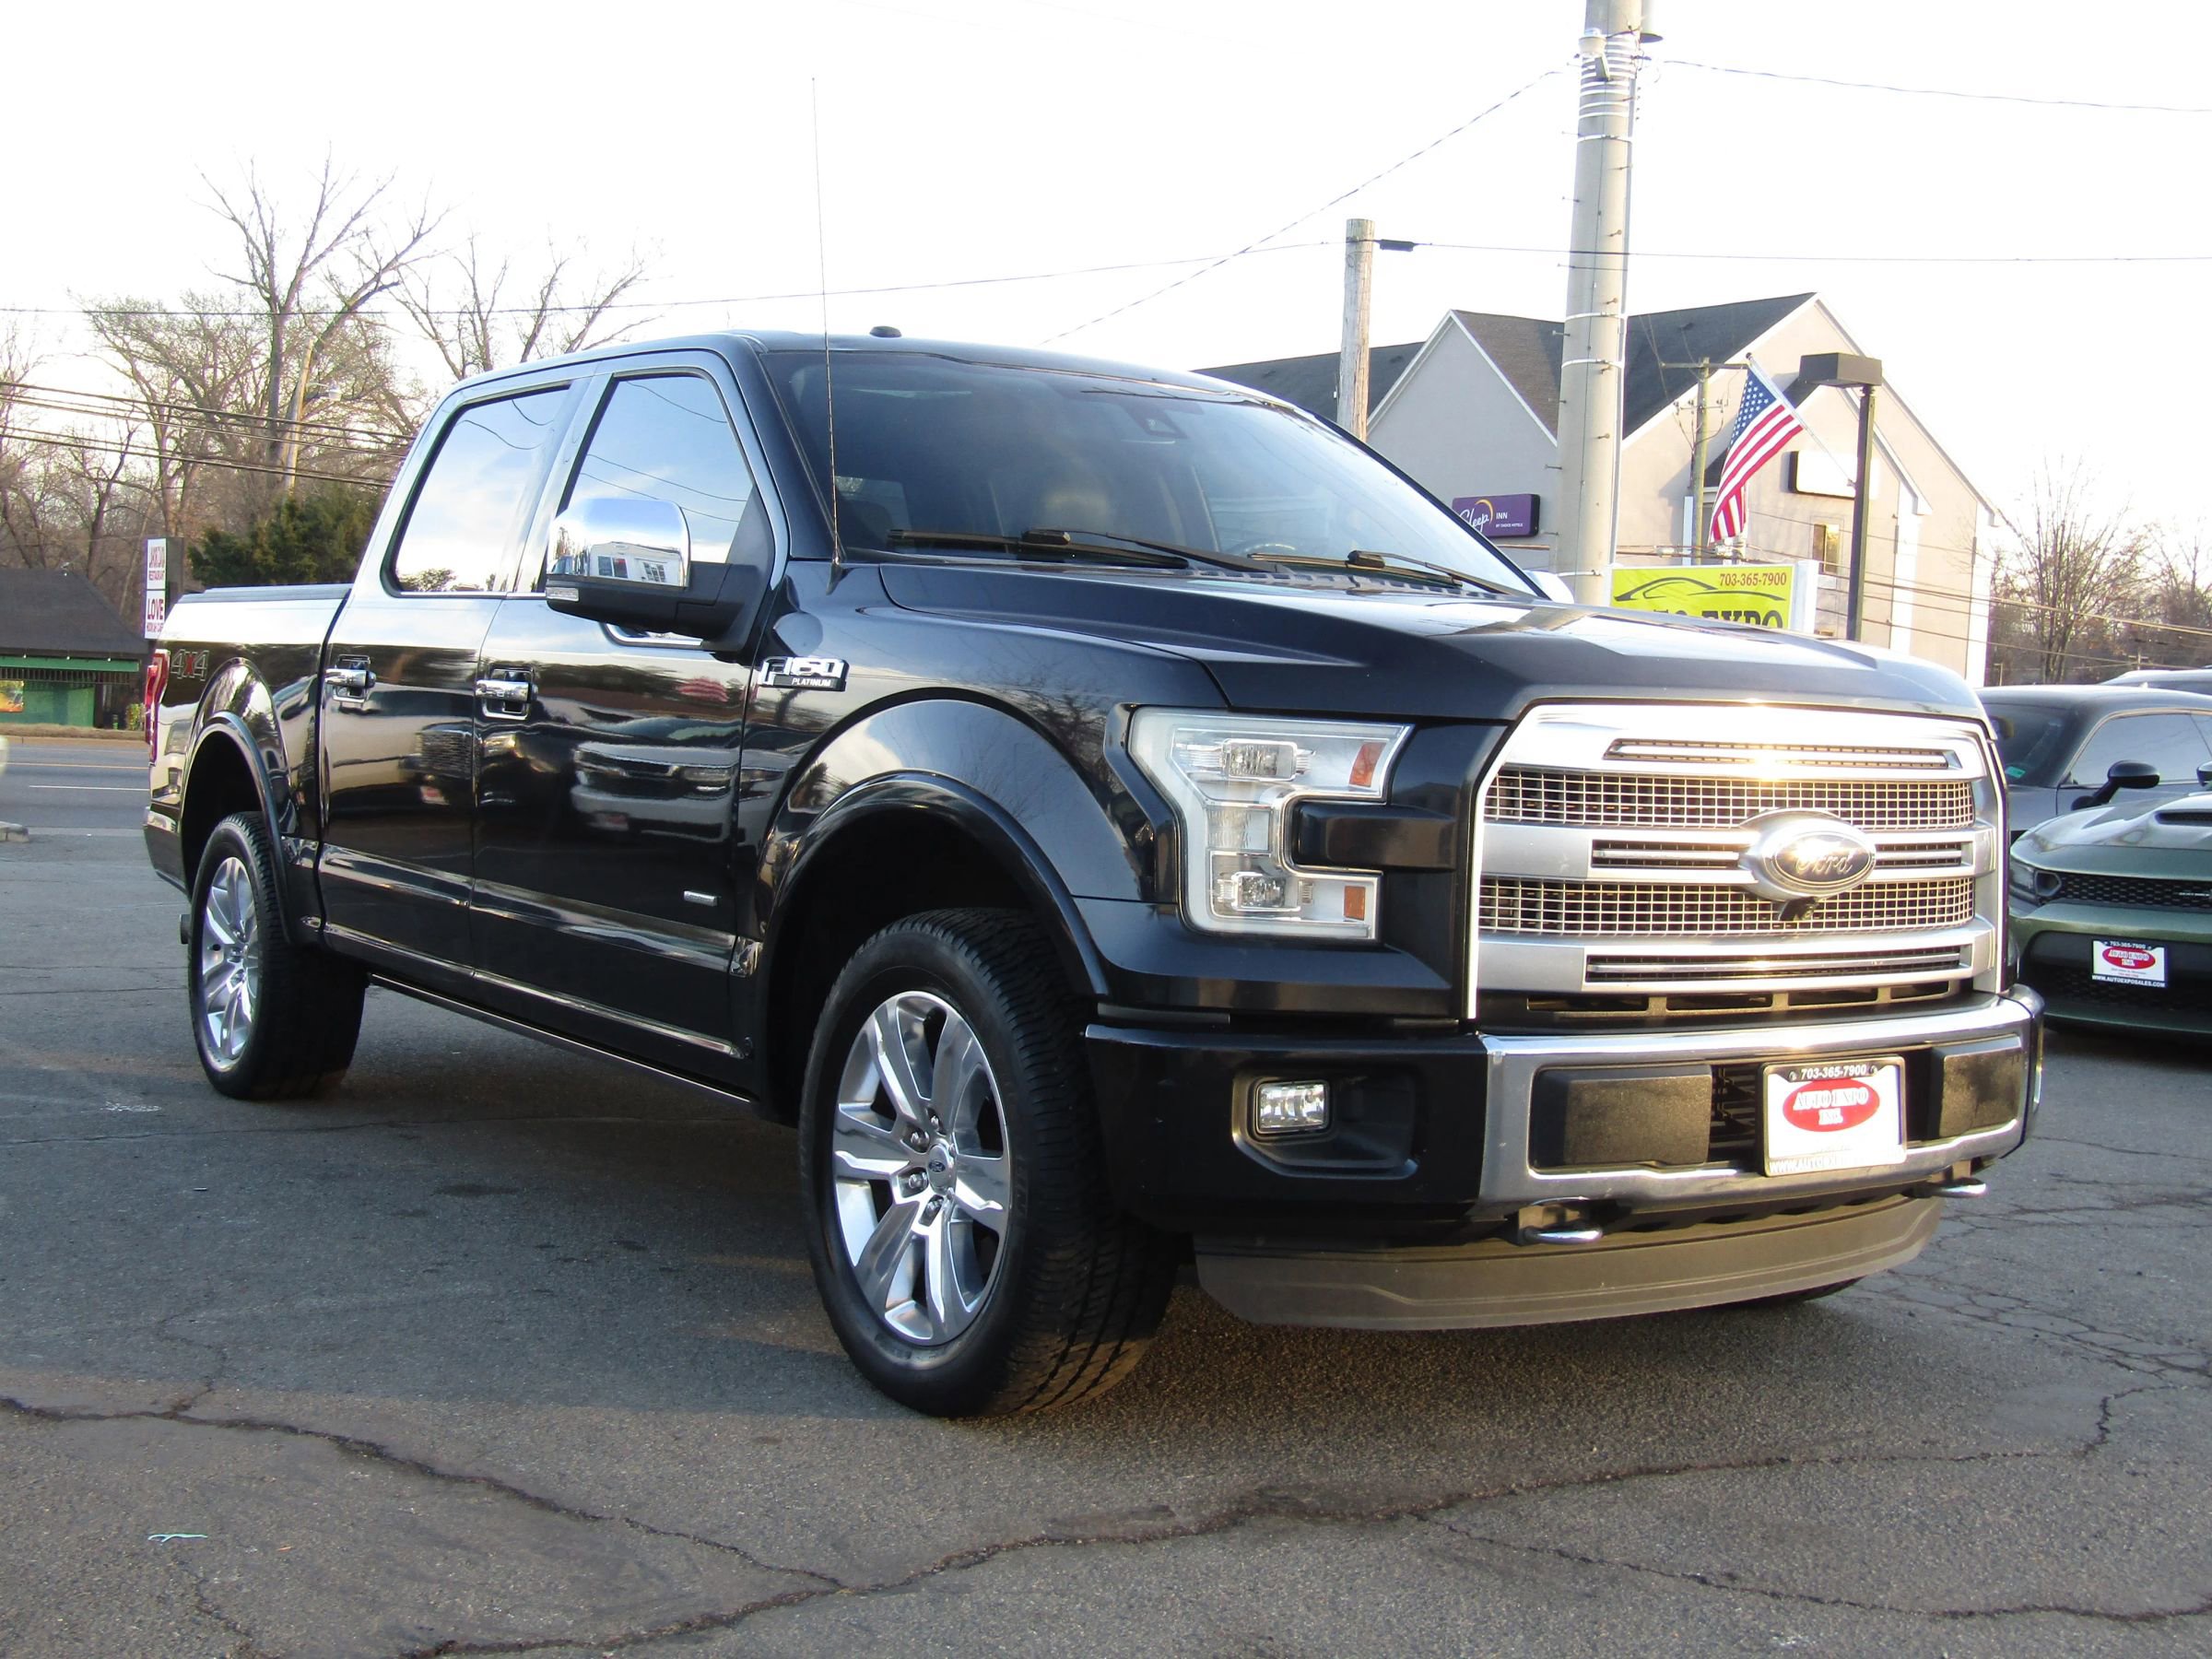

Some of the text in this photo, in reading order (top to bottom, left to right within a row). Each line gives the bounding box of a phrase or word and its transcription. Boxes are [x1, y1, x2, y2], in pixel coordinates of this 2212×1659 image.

[1496, 512, 1508, 520] INN
[1719, 572, 1787, 586] 703-365-7900
[147, 598, 164, 620] LOVE
[792, 677, 831, 687] PLATINUM
[1801, 1065, 1867, 1079] 703-365-7900
